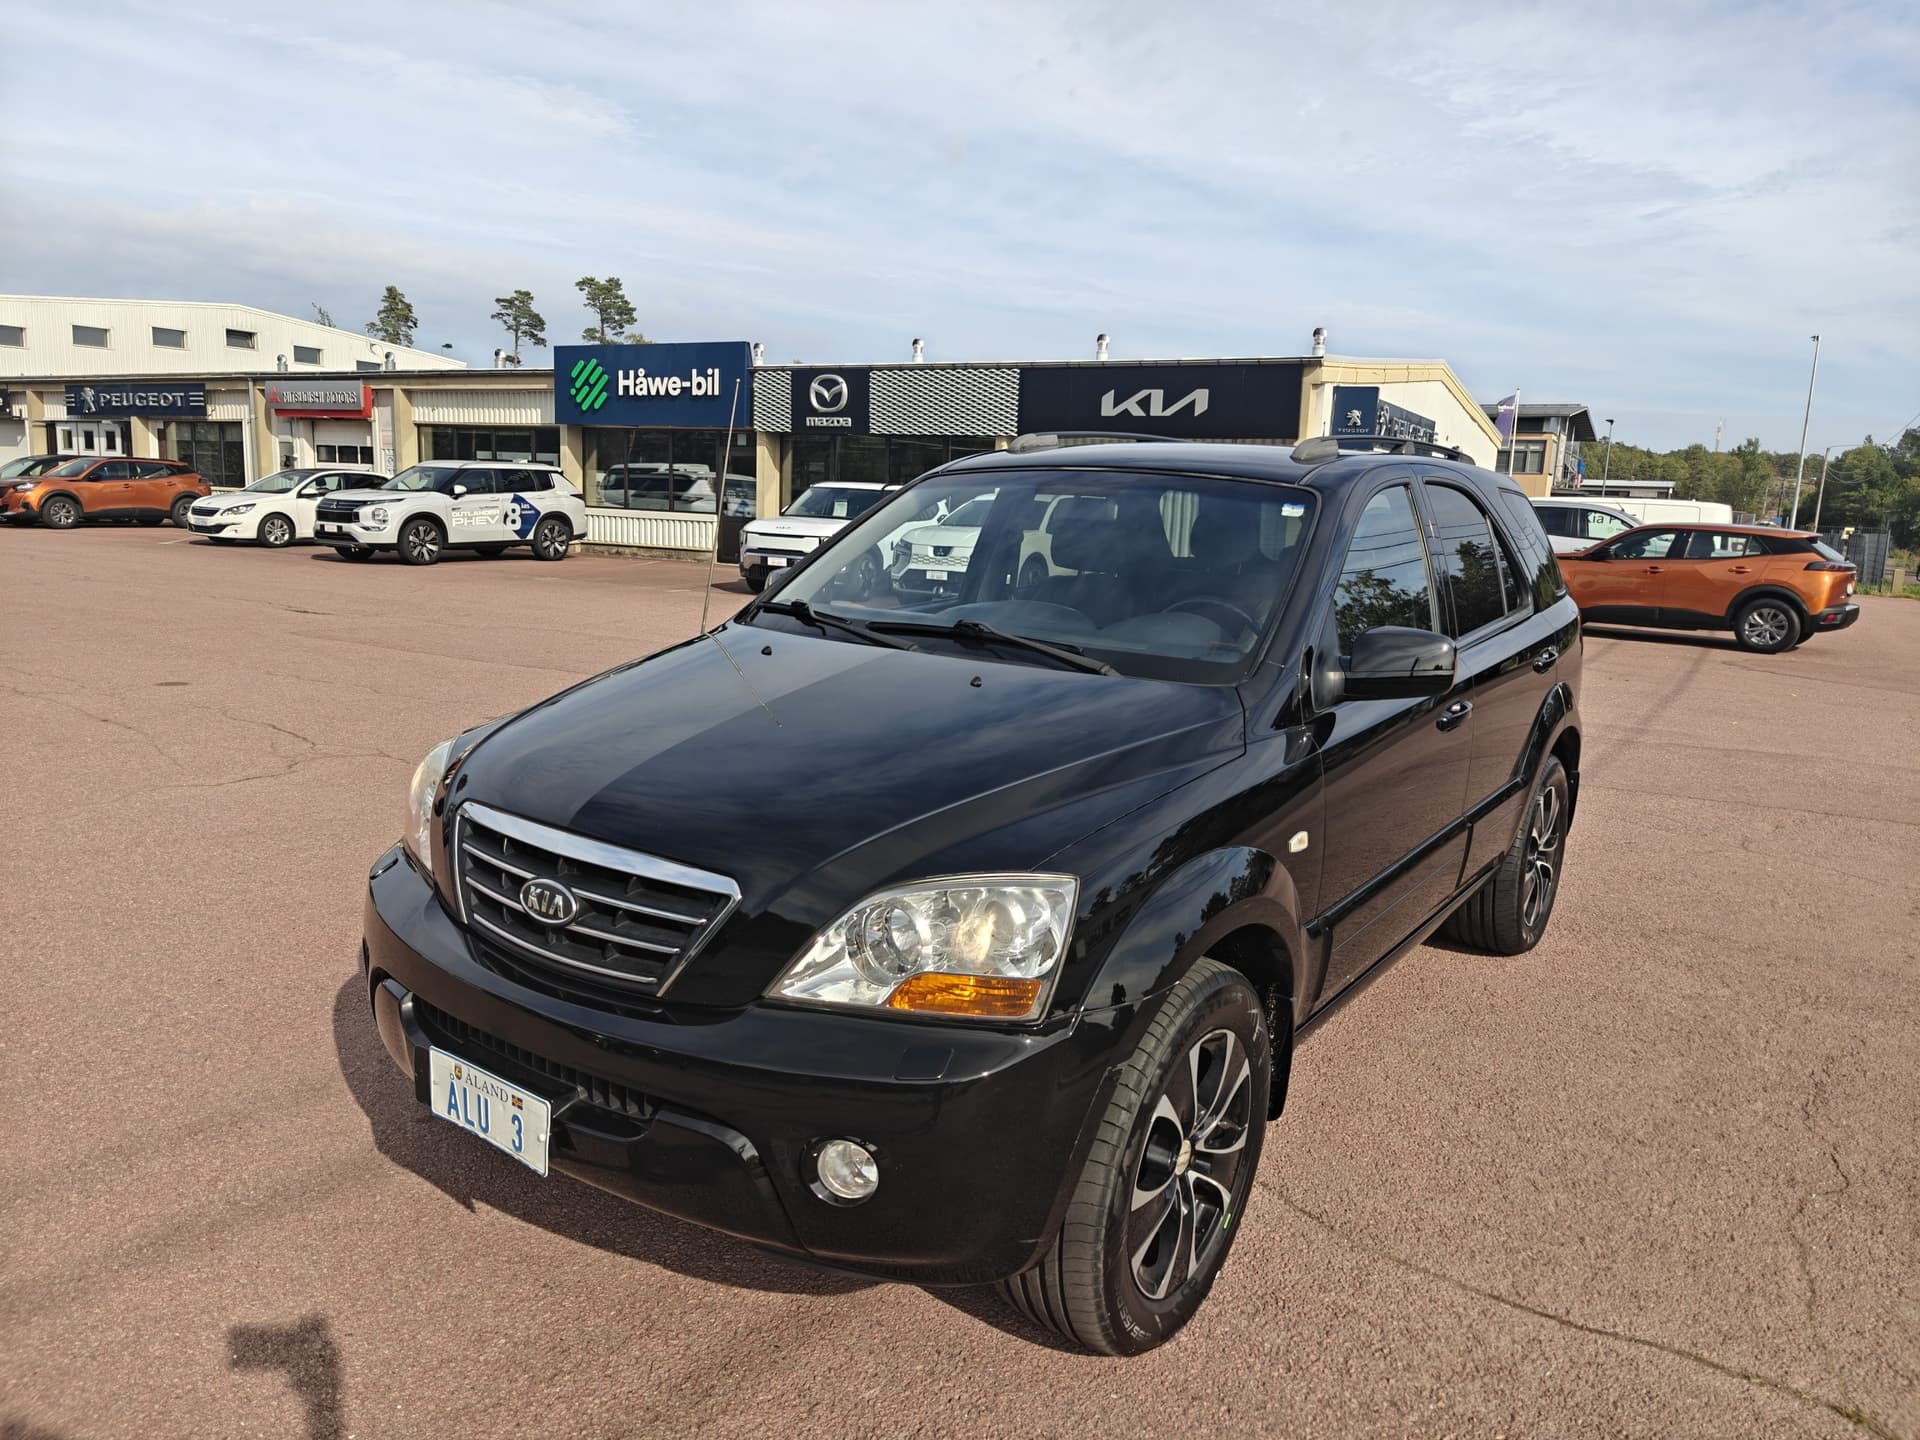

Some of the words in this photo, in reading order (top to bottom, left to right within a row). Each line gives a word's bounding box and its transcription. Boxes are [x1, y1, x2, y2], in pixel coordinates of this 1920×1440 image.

[617, 367, 720, 396] Håwe-bil
[98, 392, 185, 407] PEUGEOT
[326, 391, 358, 404] MOTORS
[805, 416, 852, 428] mazda
[452, 514, 500, 527] PHEV
[505, 502, 522, 531] 8
[527, 885, 564, 919] KIA
[511, 1113, 524, 1154] 3
